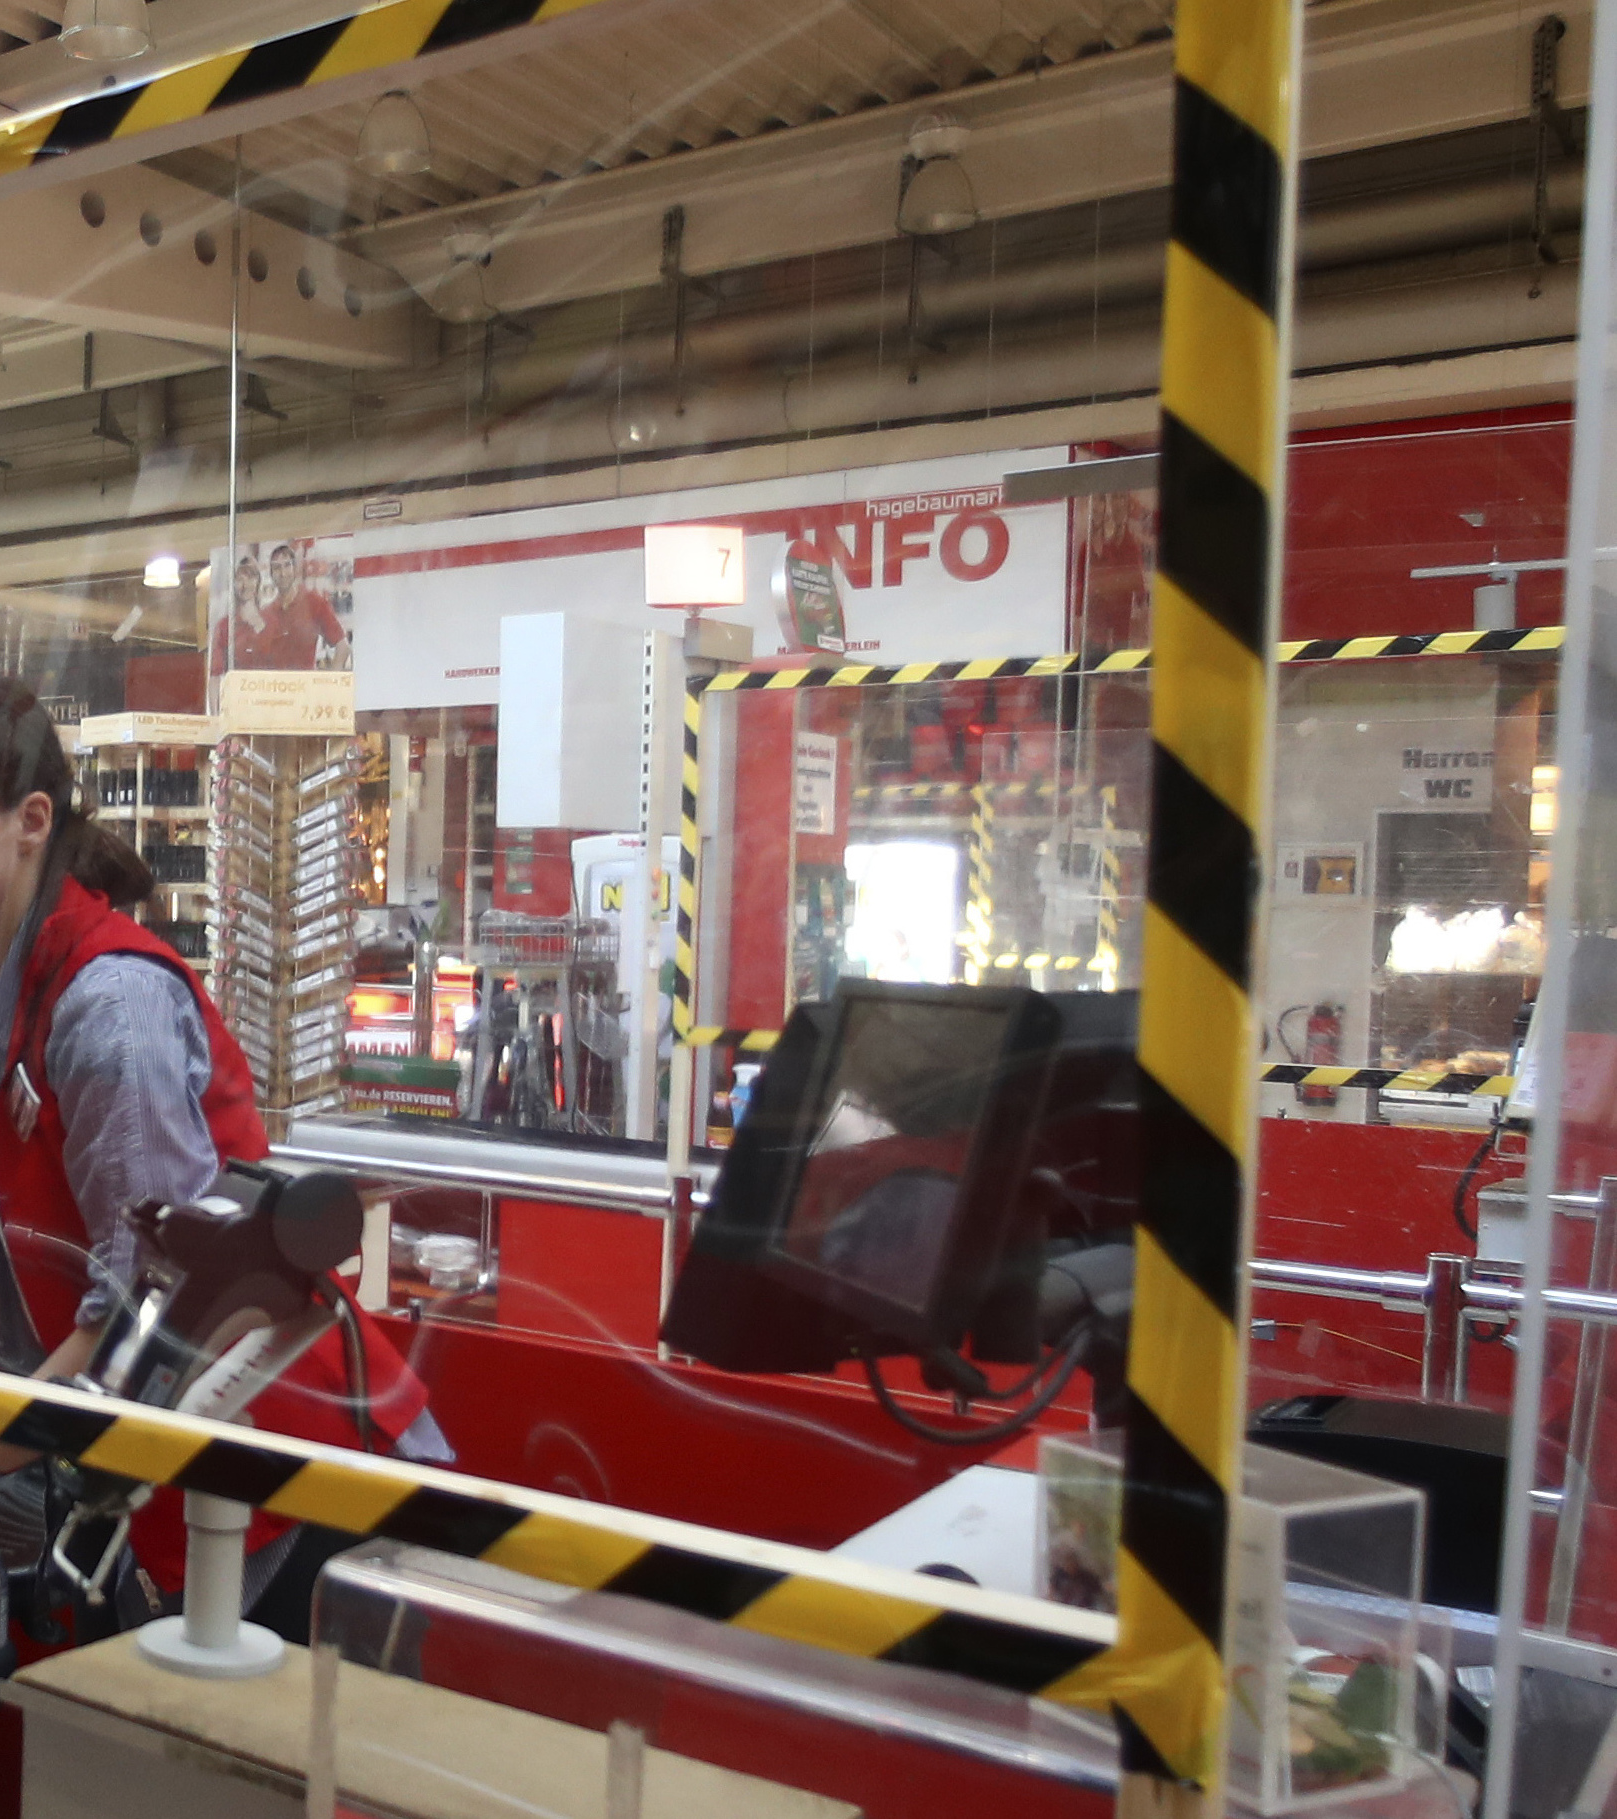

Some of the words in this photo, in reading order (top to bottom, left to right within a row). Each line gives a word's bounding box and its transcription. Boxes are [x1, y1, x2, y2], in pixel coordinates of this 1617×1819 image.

[786, 508, 1010, 591] NFO
[717, 548, 731, 578] 7
[1402, 747, 1495, 769] Herren
[1424, 778, 1473, 800] WC
